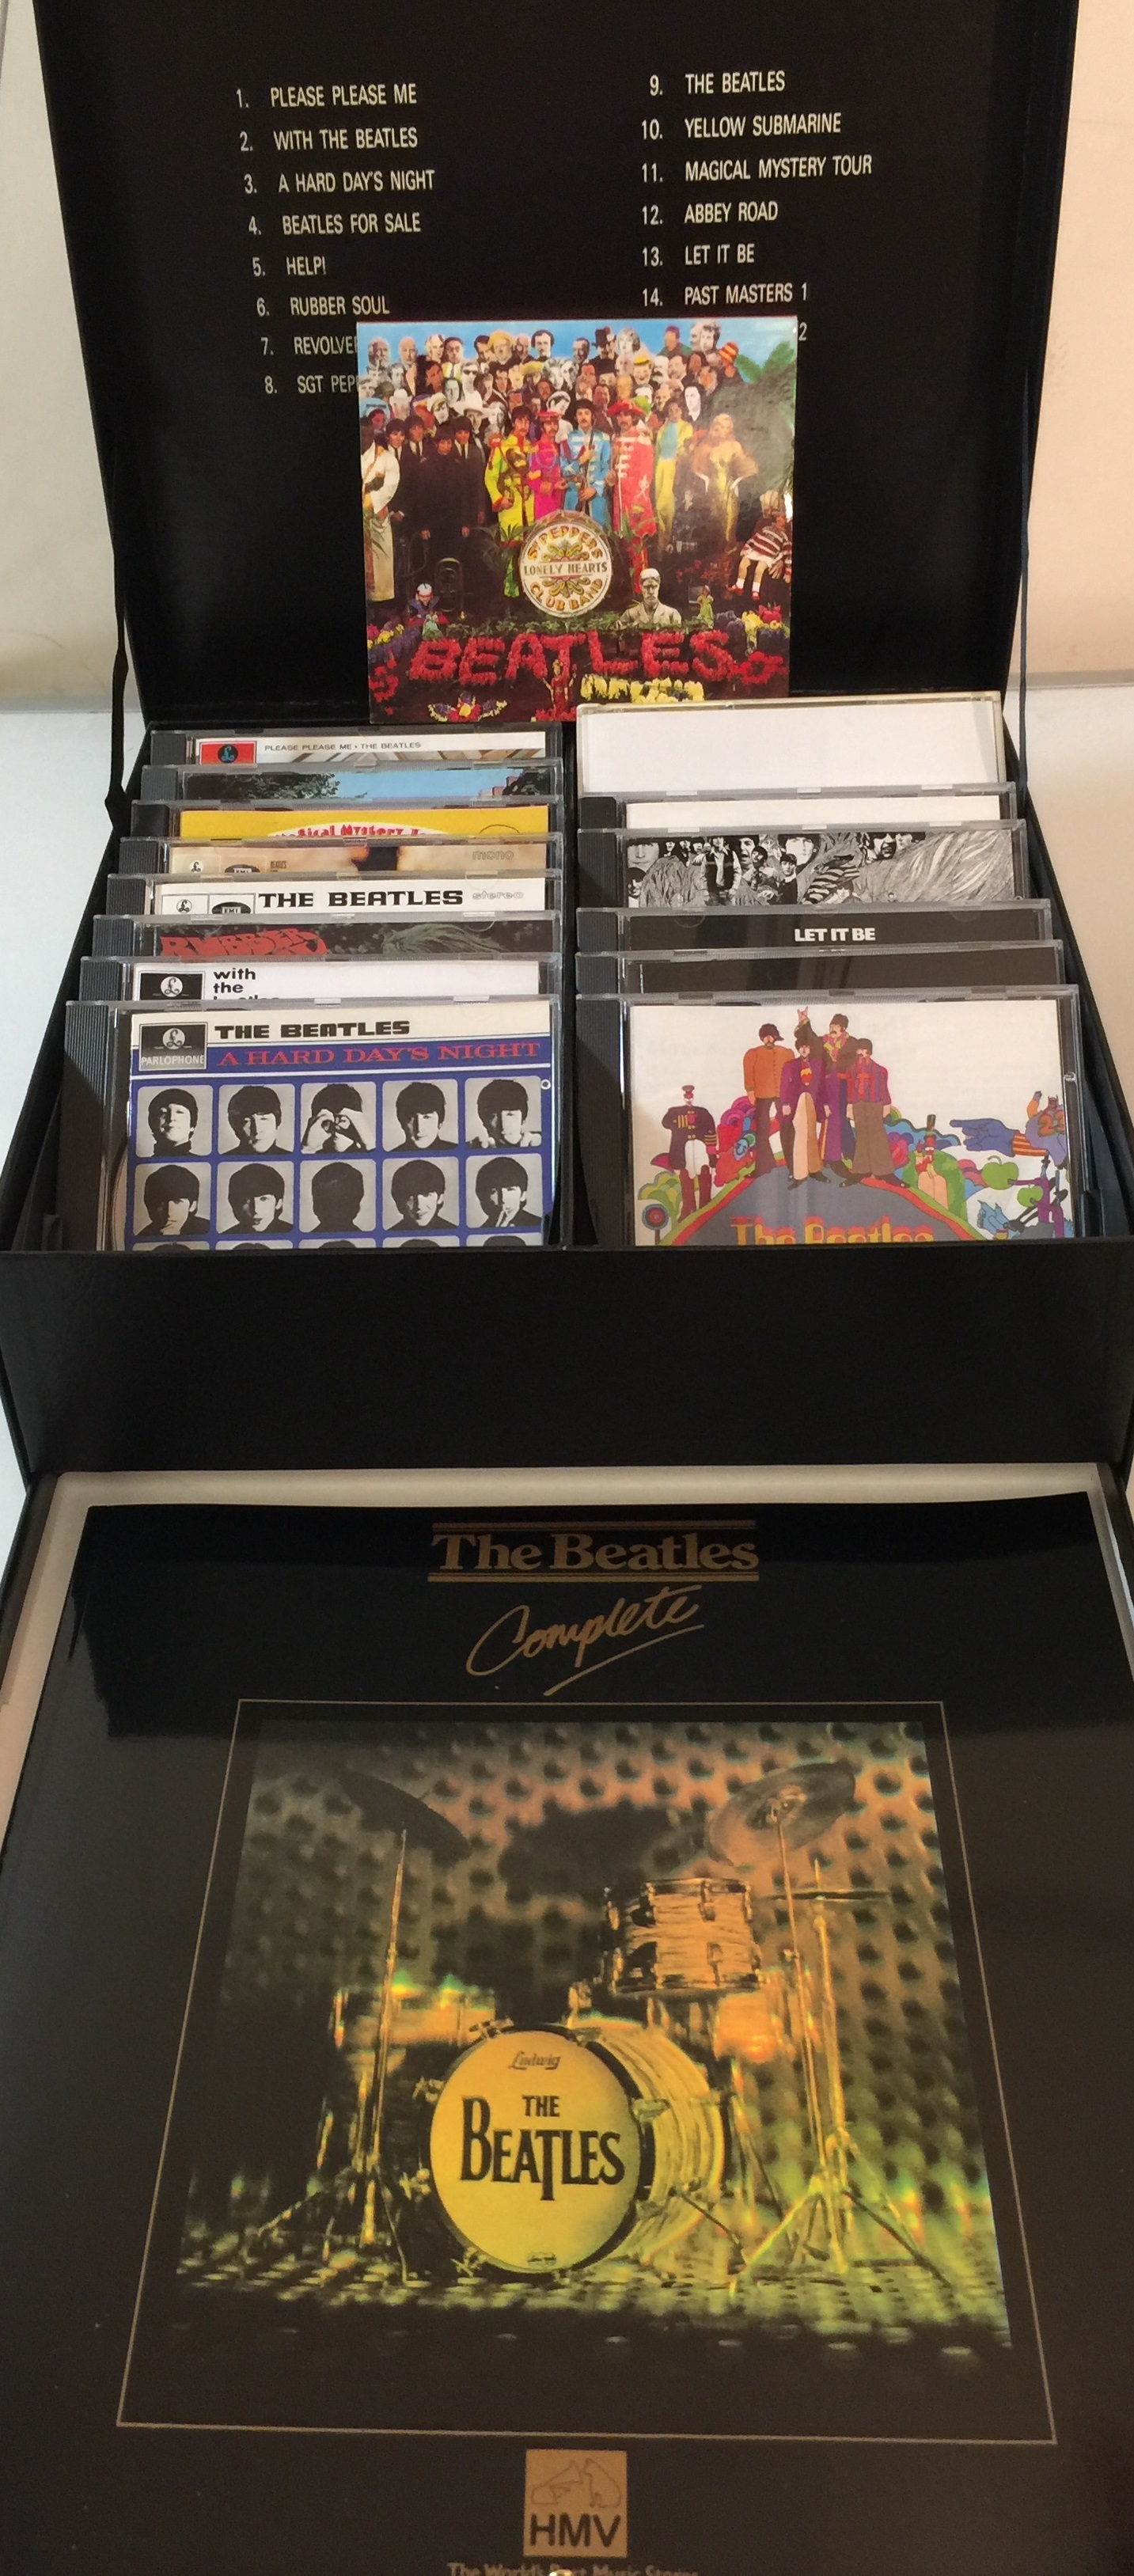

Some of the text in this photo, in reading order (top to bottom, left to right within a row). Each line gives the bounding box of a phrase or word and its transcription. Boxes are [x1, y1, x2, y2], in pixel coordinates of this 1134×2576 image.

[650, 70, 785, 96] 9. THE BEATLES
[237, 84, 416, 108] 1. PLEASE PLEASE ME
[642, 112, 841, 139] 10. YELLOW SUBMARINE
[240, 127, 417, 151] 2. WITH THE BEATLES
[643, 154, 871, 182] 11. MAGICAL MYSTERY TOUR
[245, 170, 434, 194] 3. A HARD DAY'S NIGHT
[249, 212, 420, 234] 4. BEATLES FOR SALE
[643, 201, 778, 225] 12. ABBEY ROAD
[252, 256, 325, 276] 5. HELP!
[643, 244, 754, 266] 13. LET IT BE
[643, 283, 806, 306] 14. PAST MASTERS 1
[257, 296, 390, 316] 6. RUBBER SOUL
[798, 322, 807, 341] 2
[261, 337, 273, 355] 7.
[265, 375, 358, 393] 8. SGT PEP
[524, 561, 608, 576] LONELY HEARTS
[408, 630, 736, 686] BEATLES
[259, 890, 523, 908] THE BEATLES stereo
[795, 928, 876, 942] LET IT BE
[214, 968, 256, 980] with
[214, 982, 244, 994] the
[214, 1020, 410, 1039] THE BEATLES
[141, 1055, 205, 1067] PARLOPHONE
[217, 1041, 540, 1066] A HARD DAY'S NIGHT
[431, 1532, 759, 1571] The Beatles
[466, 1584, 702, 1676] Complete
[508, 2051, 561, 2070] Ludwig
[522, 2094, 560, 2118] THE
[459, 2094, 625, 2201] BEATLES
[529, 2512, 622, 2548] HMV
